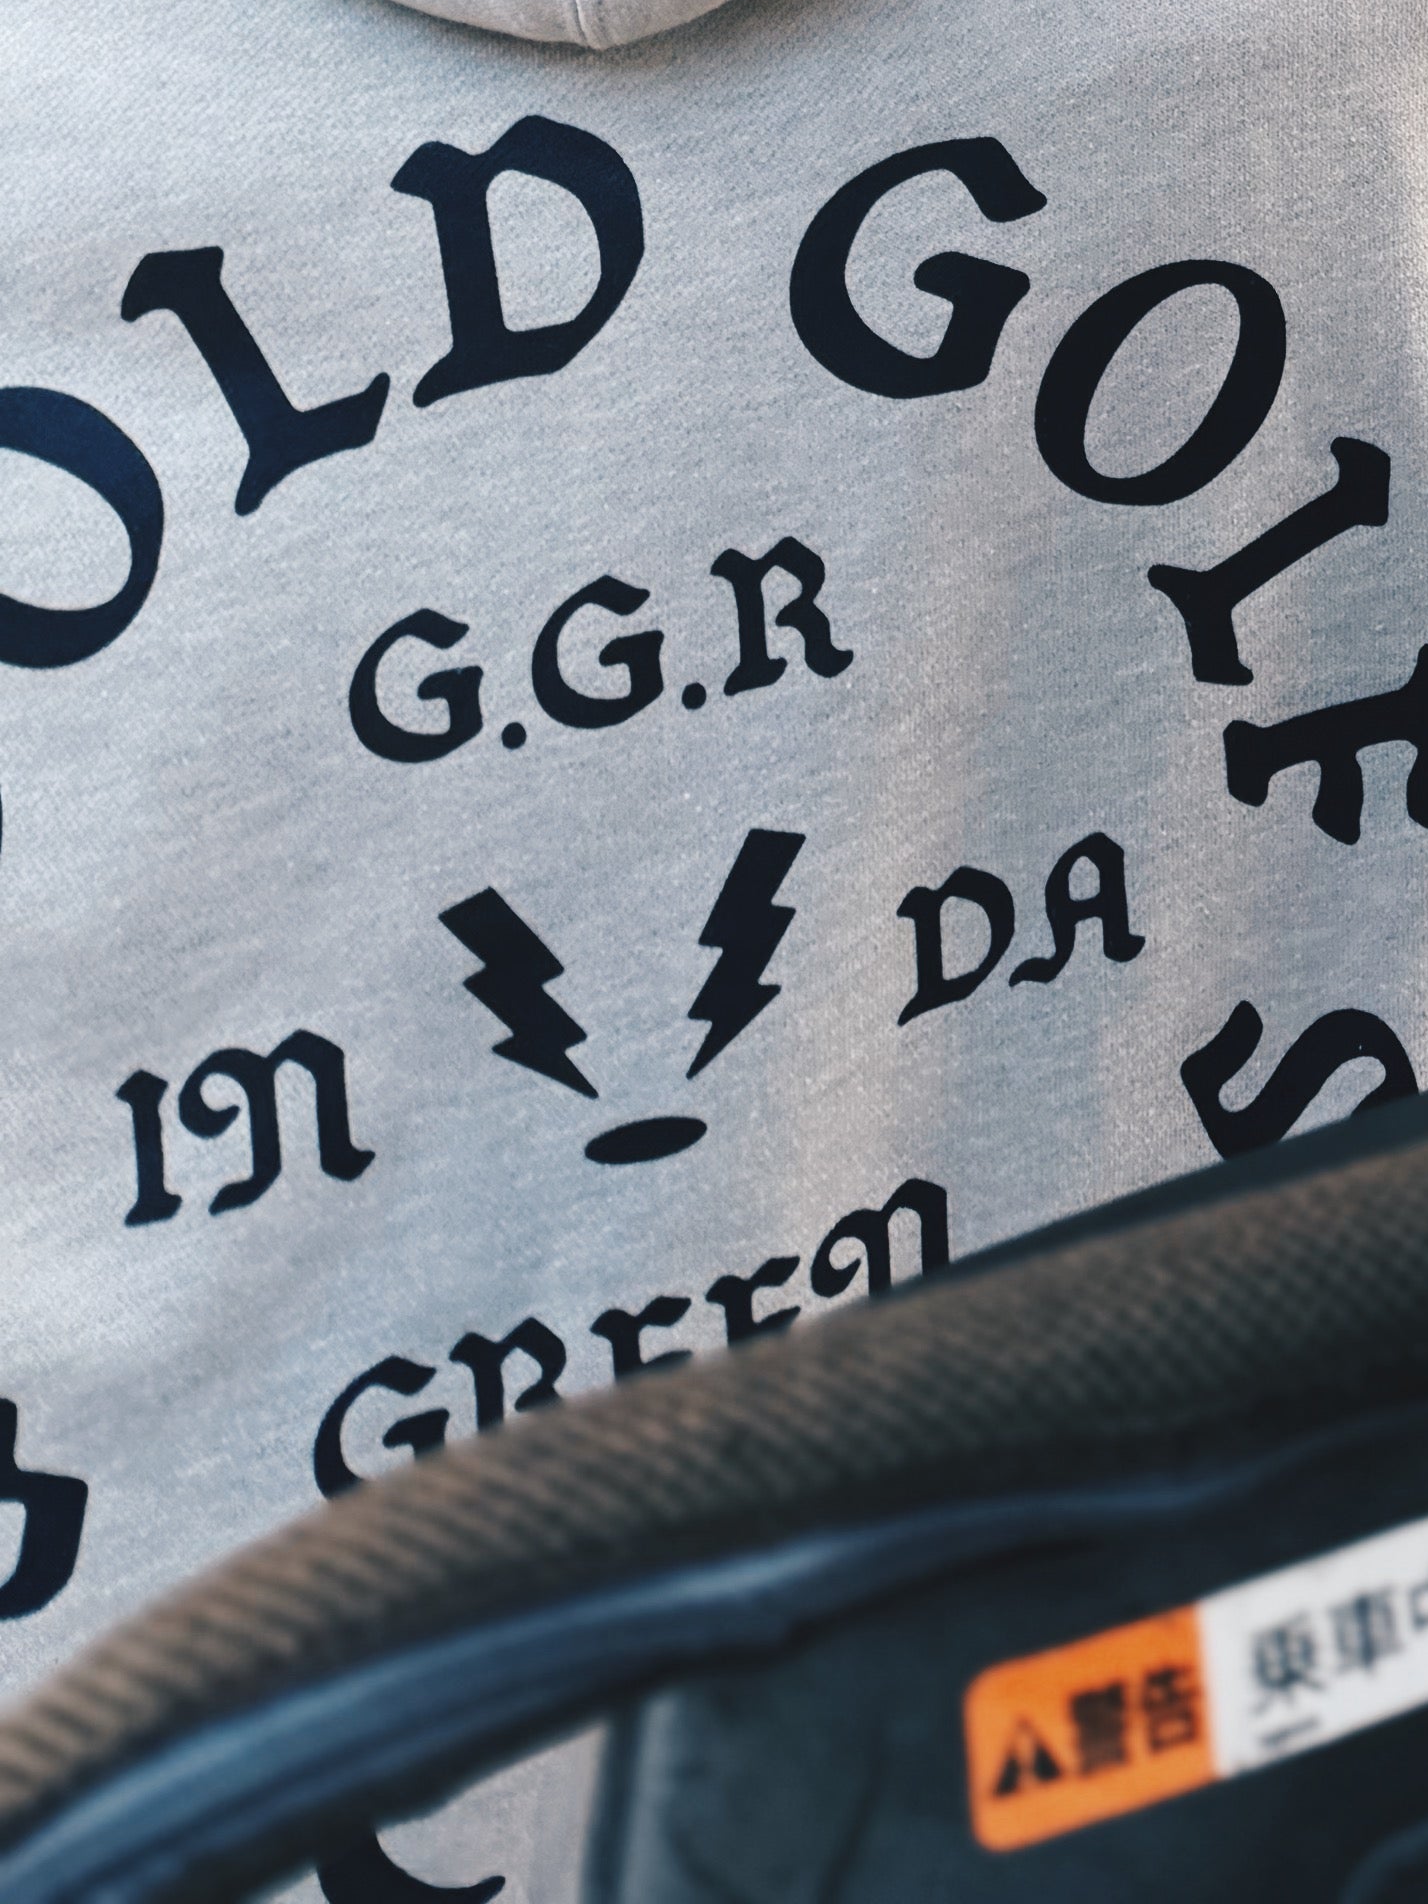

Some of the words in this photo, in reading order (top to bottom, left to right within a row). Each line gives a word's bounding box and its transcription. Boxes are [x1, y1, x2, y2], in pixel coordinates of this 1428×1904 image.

[348, 536, 853, 764] G.G.R
[116, 1029, 376, 1227] IN
[897, 832, 1146, 1027] DA
[1069, 1666, 1198, 1779] 警告
